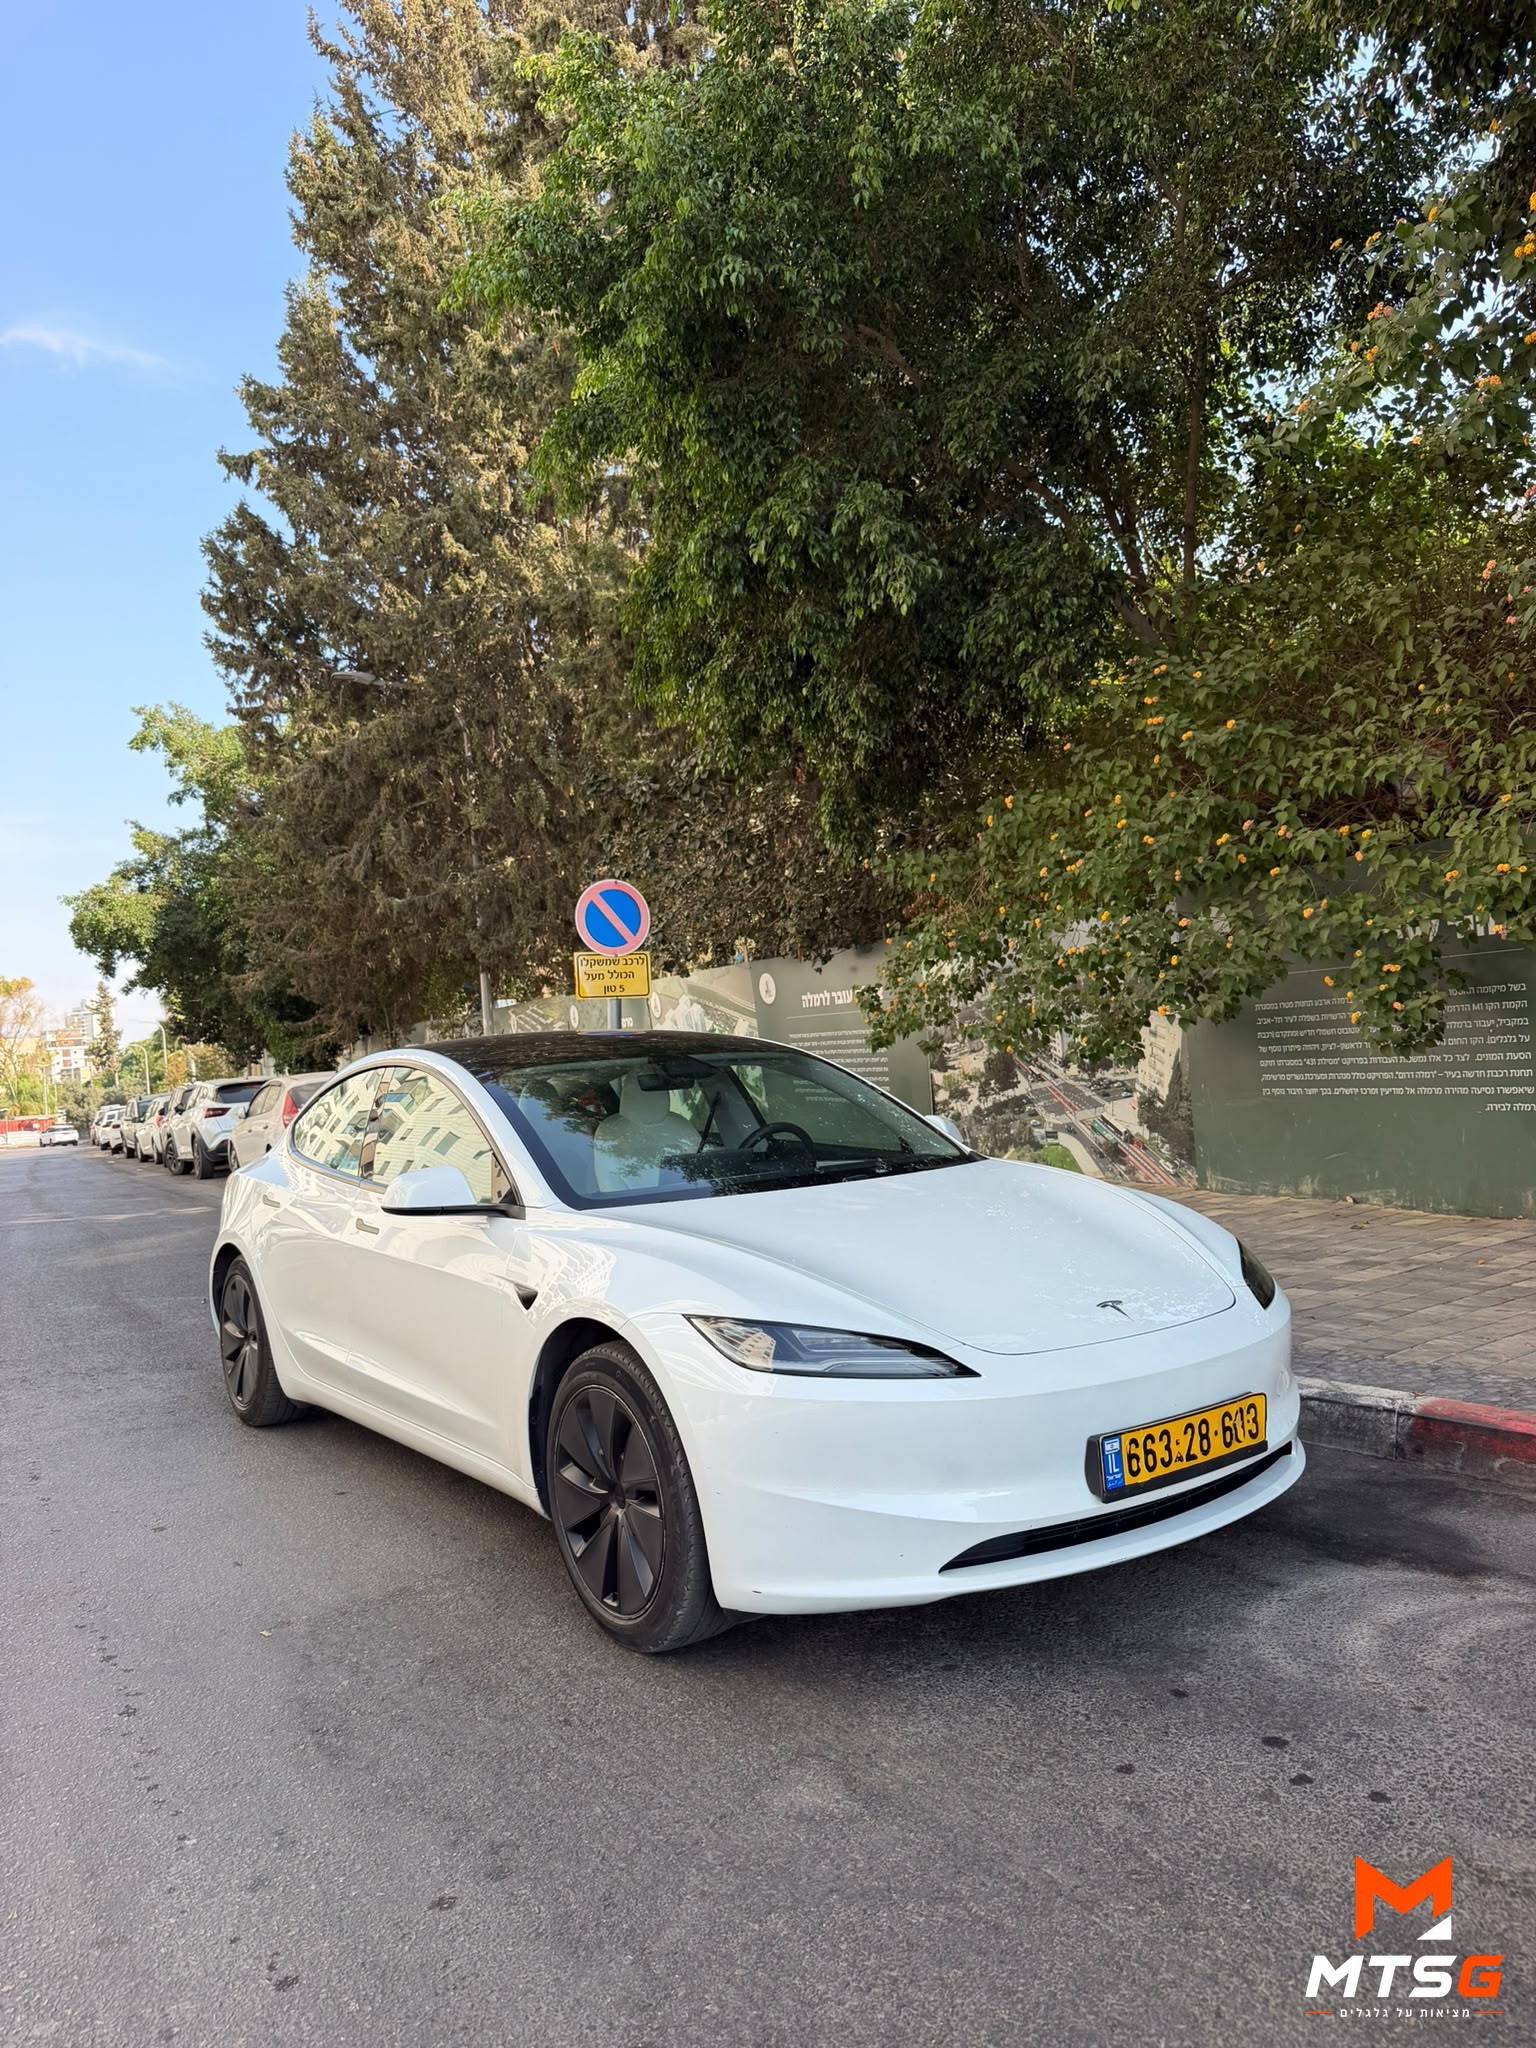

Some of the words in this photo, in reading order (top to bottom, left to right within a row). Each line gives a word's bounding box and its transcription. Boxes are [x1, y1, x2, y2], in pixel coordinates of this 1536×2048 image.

[580, 957, 620, 969] שמשקלו
[623, 956, 645, 966] לרכב
[584, 971, 605, 981] מעל
[607, 969, 635, 979] הכולל
[603, 985, 617, 995] טון
[1476, 985, 1507, 995] מיקומה
[1507, 982, 1527, 991] בשל
[801, 989, 830, 1008] לרמלה
[831, 988, 853, 1005] עובר
[1254, 1003, 1279, 1011] במסגרת
[1280, 1001, 1294, 1009] מטרו
[1294, 1000, 1314, 1008] תחנות
[1314, 999, 1331, 1007] ארבע
[1485, 1001, 1500, 1012] הקו
[1502, 1000, 1528, 1010] הקמת
[1283, 1015, 1298, 1023] לעיר
[1298, 1014, 1320, 1022] בשפלה
[1496, 1017, 1529, 1028] במקביל,
[1446, 1020, 1473, 1029] ברמלה
[1473, 1019, 1495, 1028] יעבור
[1316, 1028, 1337, 1036] חשמלי
[1448, 1037, 1468, 1046] החום
[1469, 1036, 1484, 1046] הקו
[1518, 1034, 1531, 1043] על
[1369, 1056, 1399, 1064] העבודות
[1428, 1054, 1442, 1062] אלו
[1442, 1054, 1454, 1062] כל
[1454, 1053, 1470, 1062] לצד
[1505, 1051, 1532, 1060] הסעת
[1259, 1060, 1276, 1068] תוקם
[1341, 1057, 1368, 1066] בפרויקט
[1286, 1073, 1304, 1081] גשרים
[1328, 1072, 1351, 1080] מנהרות
[1350, 1071, 1366, 1080] כולל
[1366, 1072, 1394, 1080] הפרויקט
[1462, 1070, 1486, 1078] חדשה
[1486, 1070, 1509, 1078] רכבת
[1509, 1069, 1533, 1078] תחנת
[1261, 1088, 1271, 1096] בין
[1271, 1088, 1286, 1096] נוסף
[1286, 1087, 1303, 1095] חיבור
[1319, 1087, 1332, 1096] בכך
[1379, 1087, 1404, 1096] מודיעין
[1405, 1087, 1416, 1095] אל
[1416, 1087, 1443, 1096] מרמלה
[1444, 1087, 1470, 1096] מהירה
[1470, 1087, 1496, 1096] נסיעה
[1496, 1086, 1535, 1095] שיאפשרו
[1108, 1453, 1120, 1474] IL
